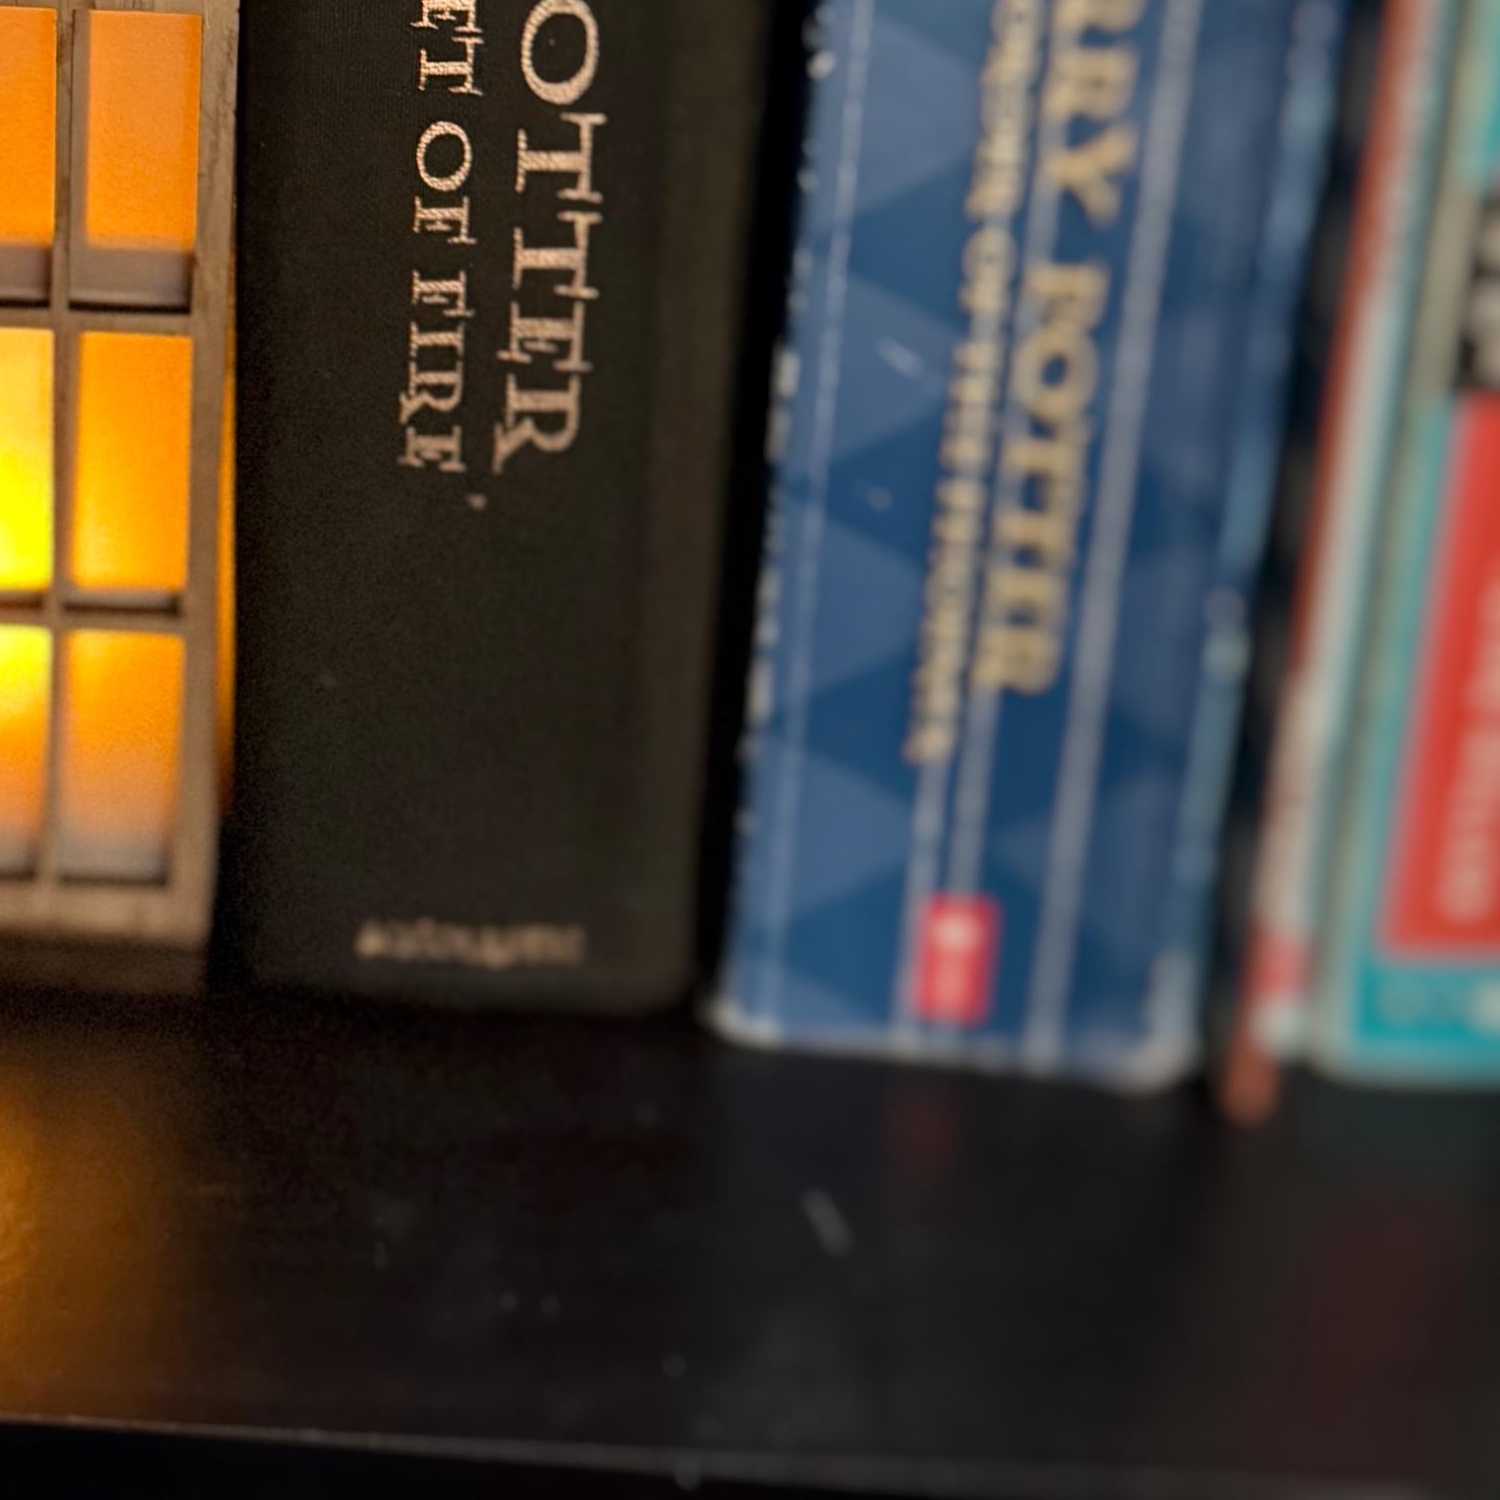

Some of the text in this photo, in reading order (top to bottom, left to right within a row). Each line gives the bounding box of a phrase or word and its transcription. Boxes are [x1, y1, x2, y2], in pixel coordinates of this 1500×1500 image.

[414, 120, 476, 245] OF
[398, 268, 474, 473] FIRE
[974, 259, 1108, 695] POTTER
